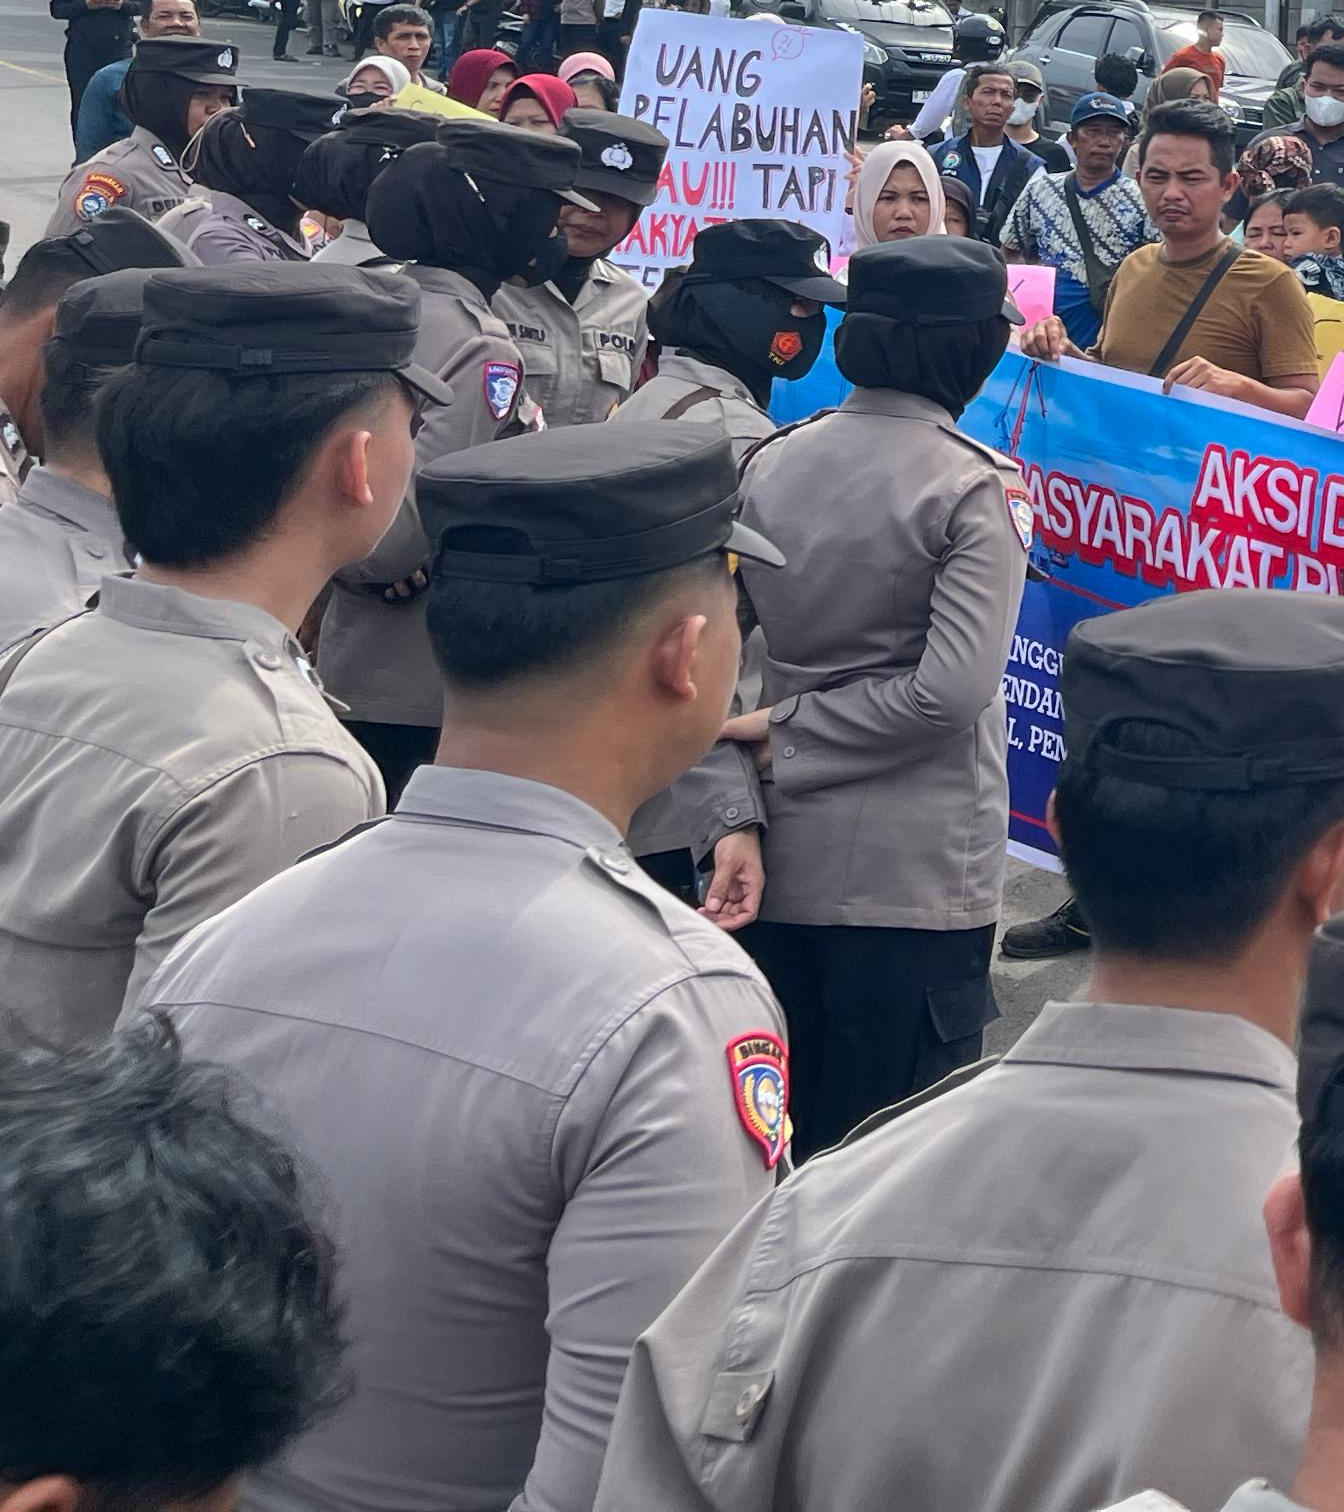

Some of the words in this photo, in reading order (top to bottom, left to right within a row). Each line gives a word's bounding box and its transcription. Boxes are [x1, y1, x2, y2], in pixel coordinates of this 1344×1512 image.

[656, 43, 762, 97] UANG
[656, 161, 737, 209] AU!!!
[752, 163, 836, 212] TAPI
[1196, 450, 1311, 537] AKSI
[1027, 470, 1284, 589] ASYARAKAT
